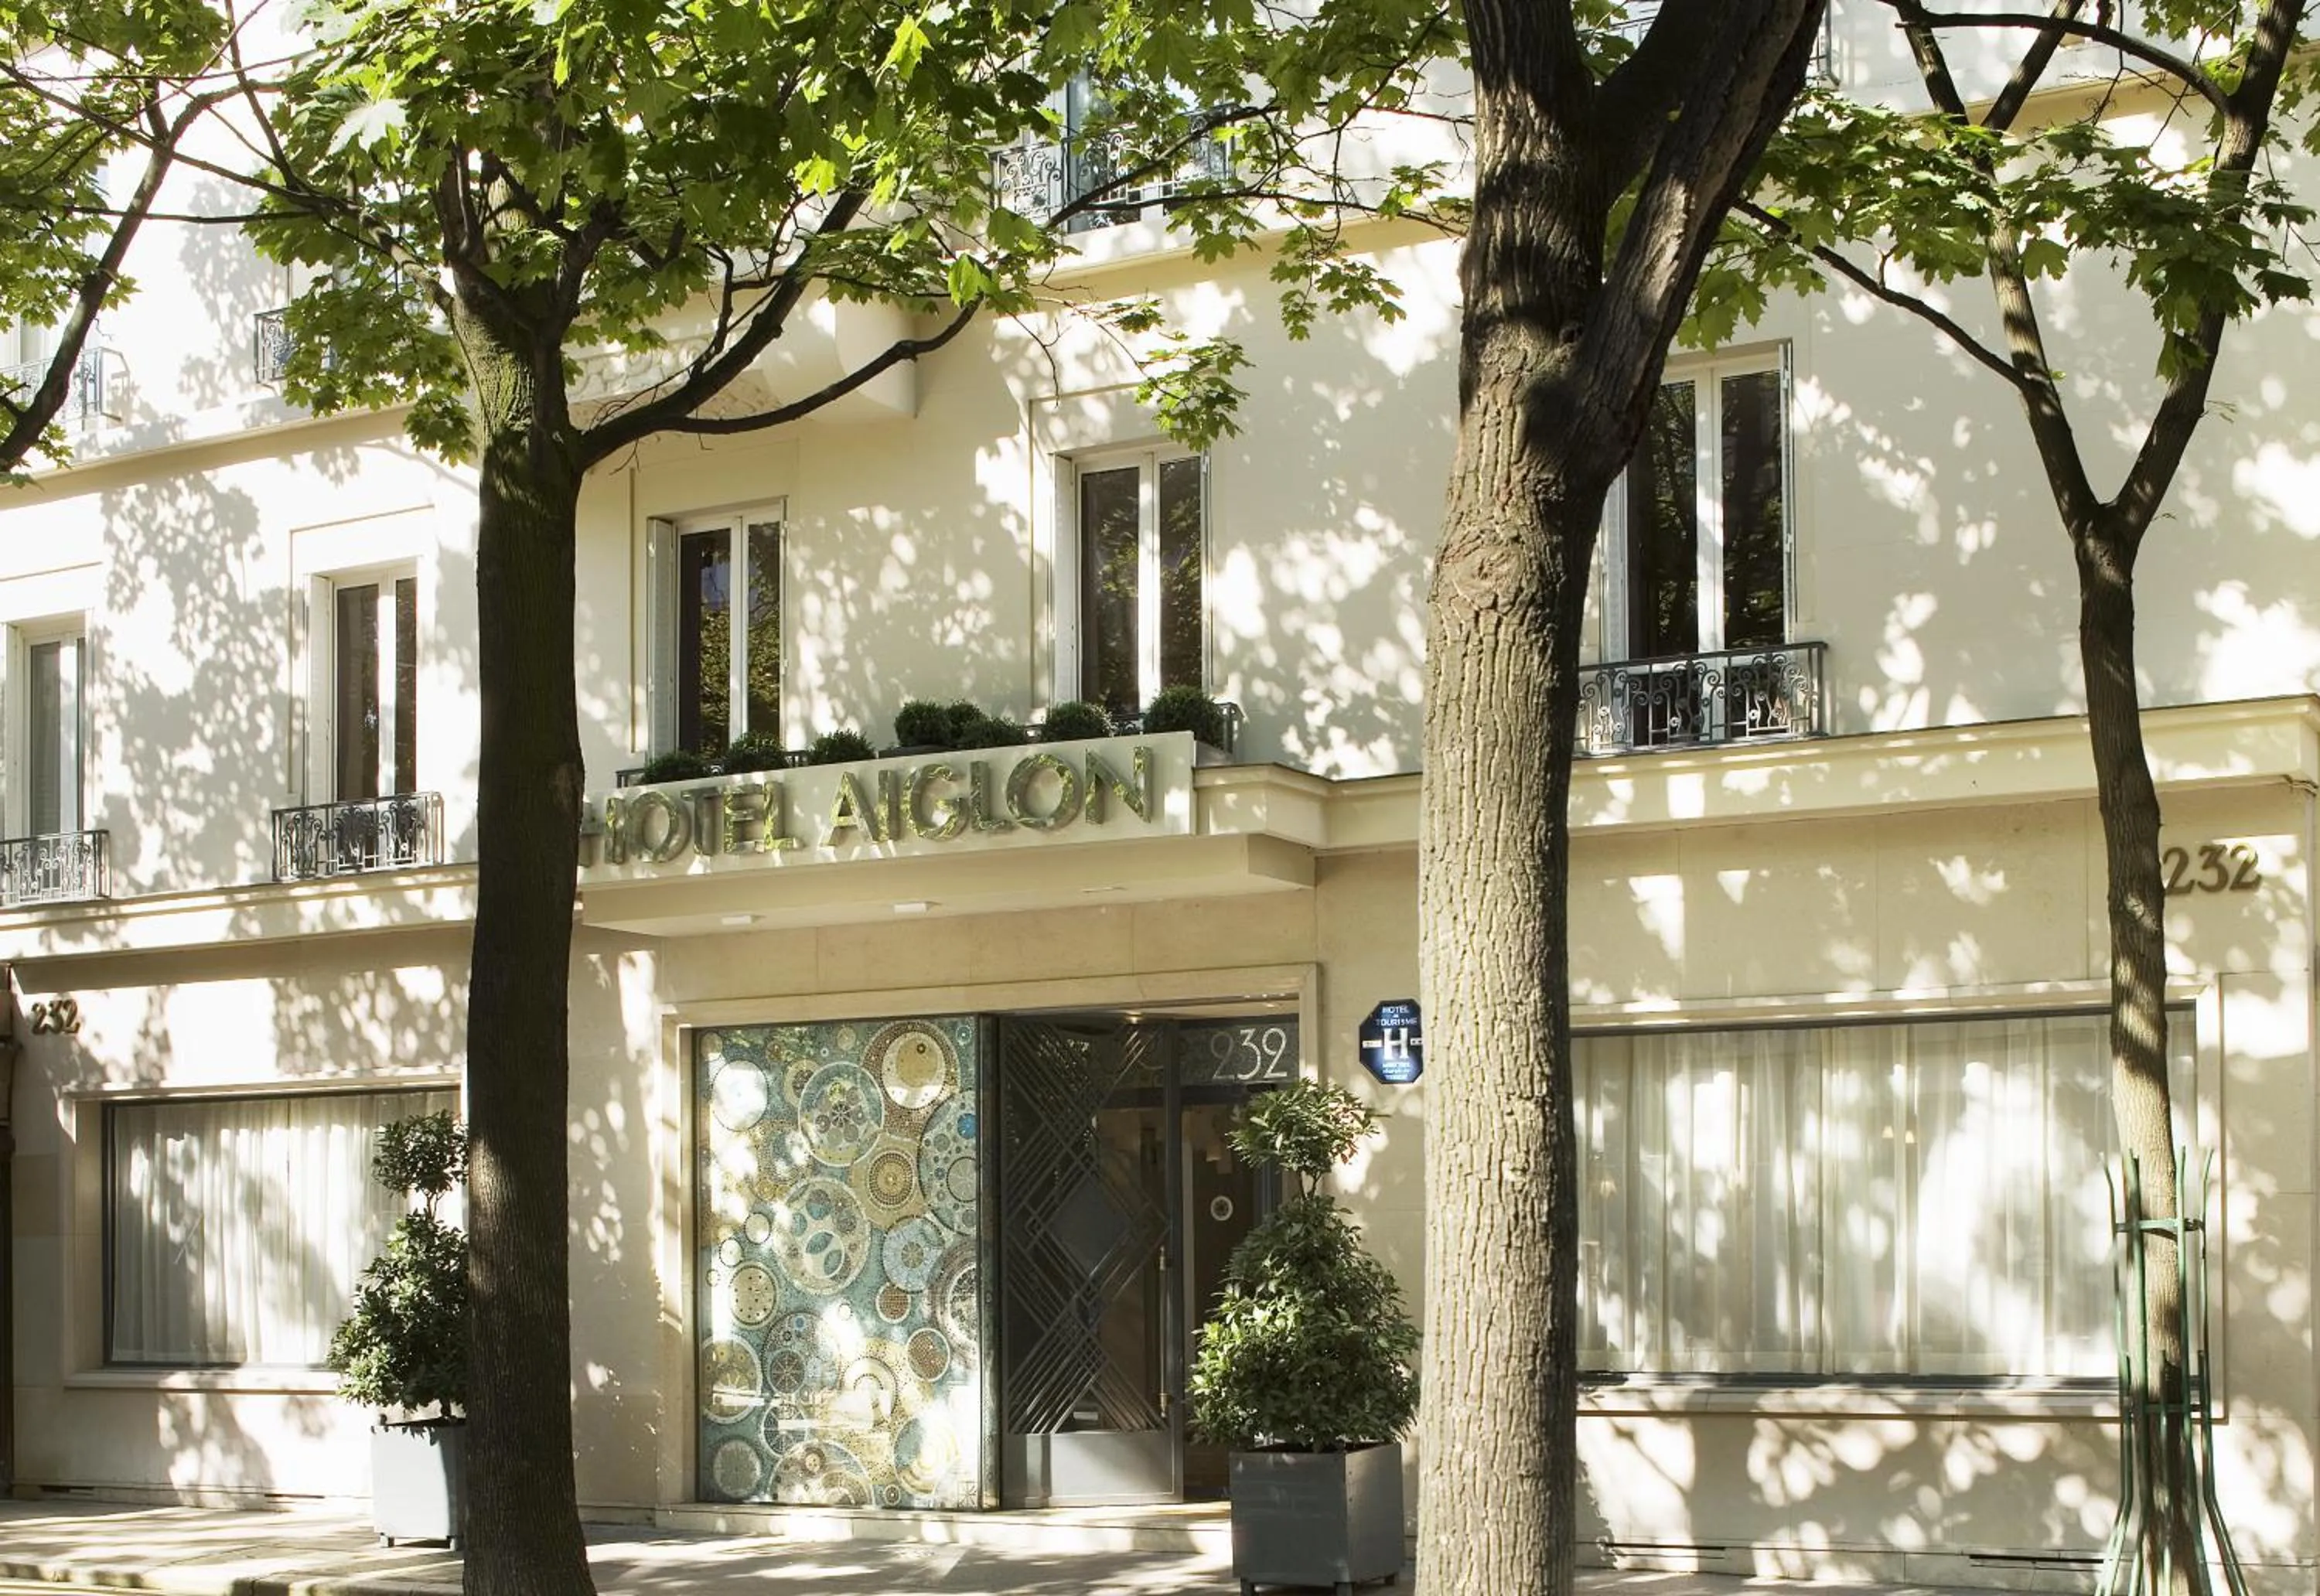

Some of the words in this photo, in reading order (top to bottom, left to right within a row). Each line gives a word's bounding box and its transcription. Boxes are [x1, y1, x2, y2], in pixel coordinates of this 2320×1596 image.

[578, 781, 803, 868] HOTEL
[818, 746, 1153, 847] AIGLON
[2162, 843, 2263, 896] 232
[31, 999, 80, 1035] 232
[1210, 1028, 1288, 1080] 232
[1383, 1028, 1408, 1059] H
